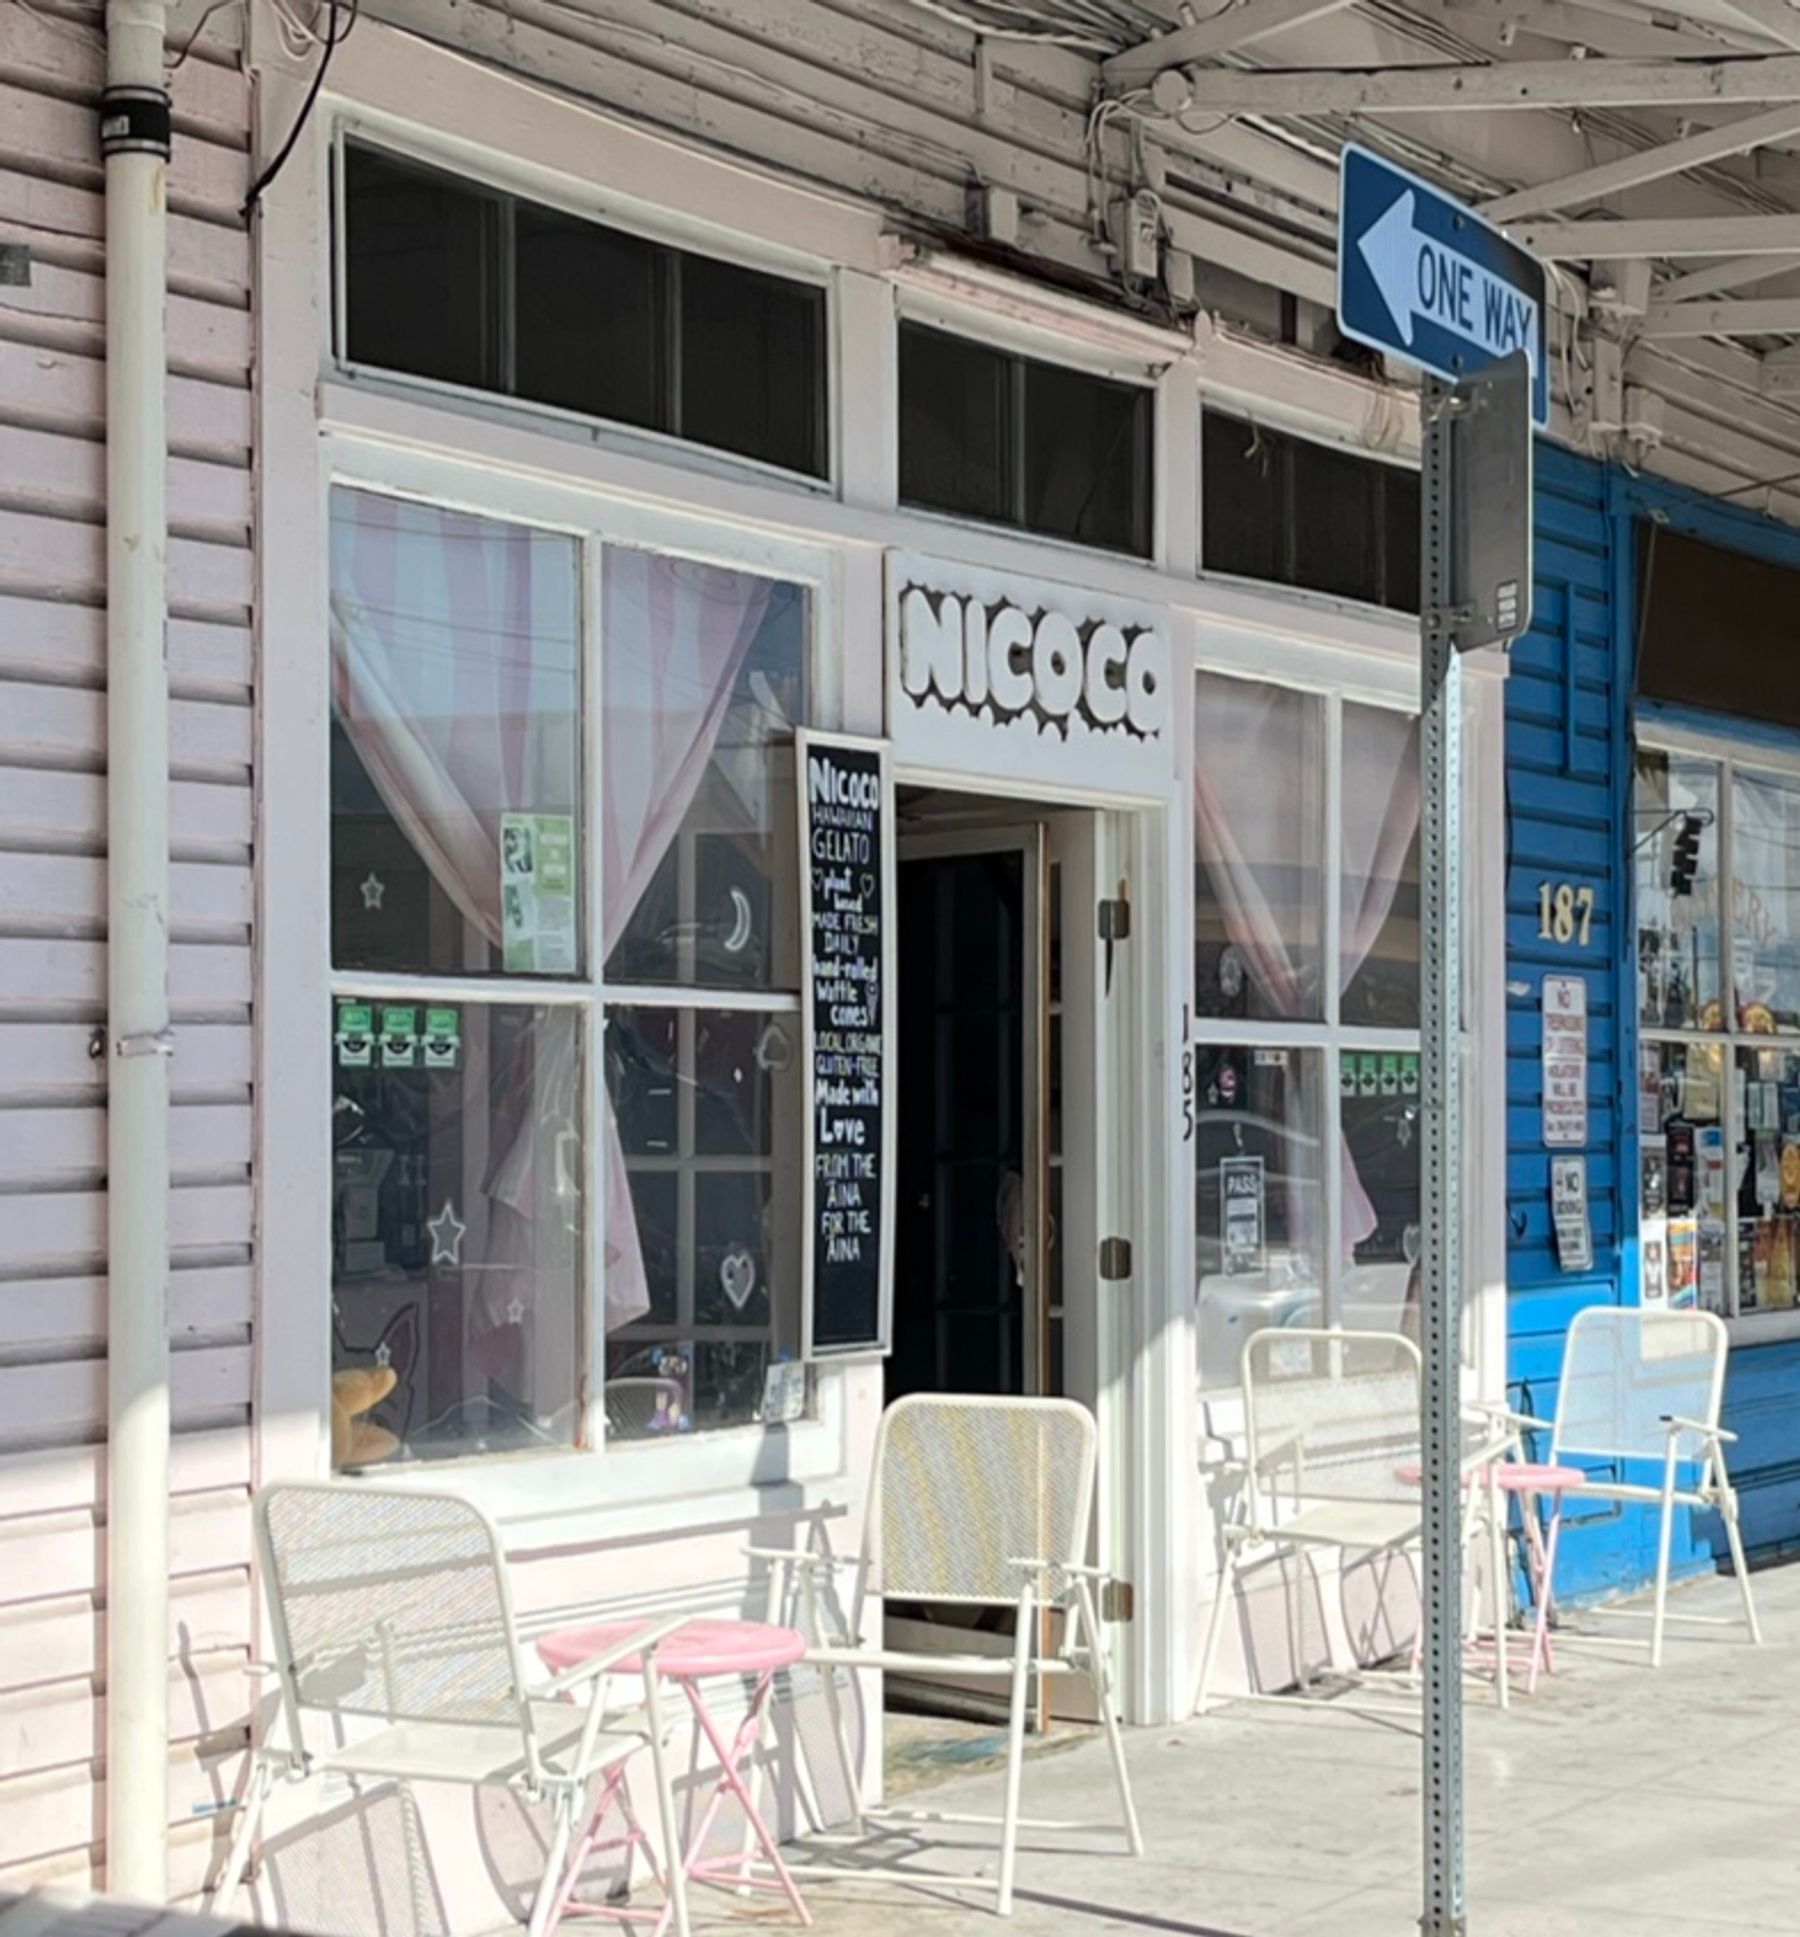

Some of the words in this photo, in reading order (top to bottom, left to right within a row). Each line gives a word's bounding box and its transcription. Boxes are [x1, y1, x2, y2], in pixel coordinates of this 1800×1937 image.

[1418, 243, 1474, 332] ONE
[1482, 277, 1533, 350] WAY
[899, 580, 1161, 741] NICOCO
[812, 827, 871, 865] GELATO
[812, 911, 840, 930] MADE
[844, 914, 879, 936] FRESH
[1538, 883, 1594, 946] 187
[824, 931, 862, 955] DAILY
[1182, 1003, 1194, 1142] 185
[815, 1078, 851, 1105] Made
[852, 1080, 880, 1107] with
[819, 1107, 866, 1145] Love
[815, 1153, 849, 1179] FROM
[853, 1153, 877, 1179] THE
[1227, 1175, 1257, 1194] PASS
[821, 1211, 844, 1235] FOR
[848, 1211, 872, 1235] THE
